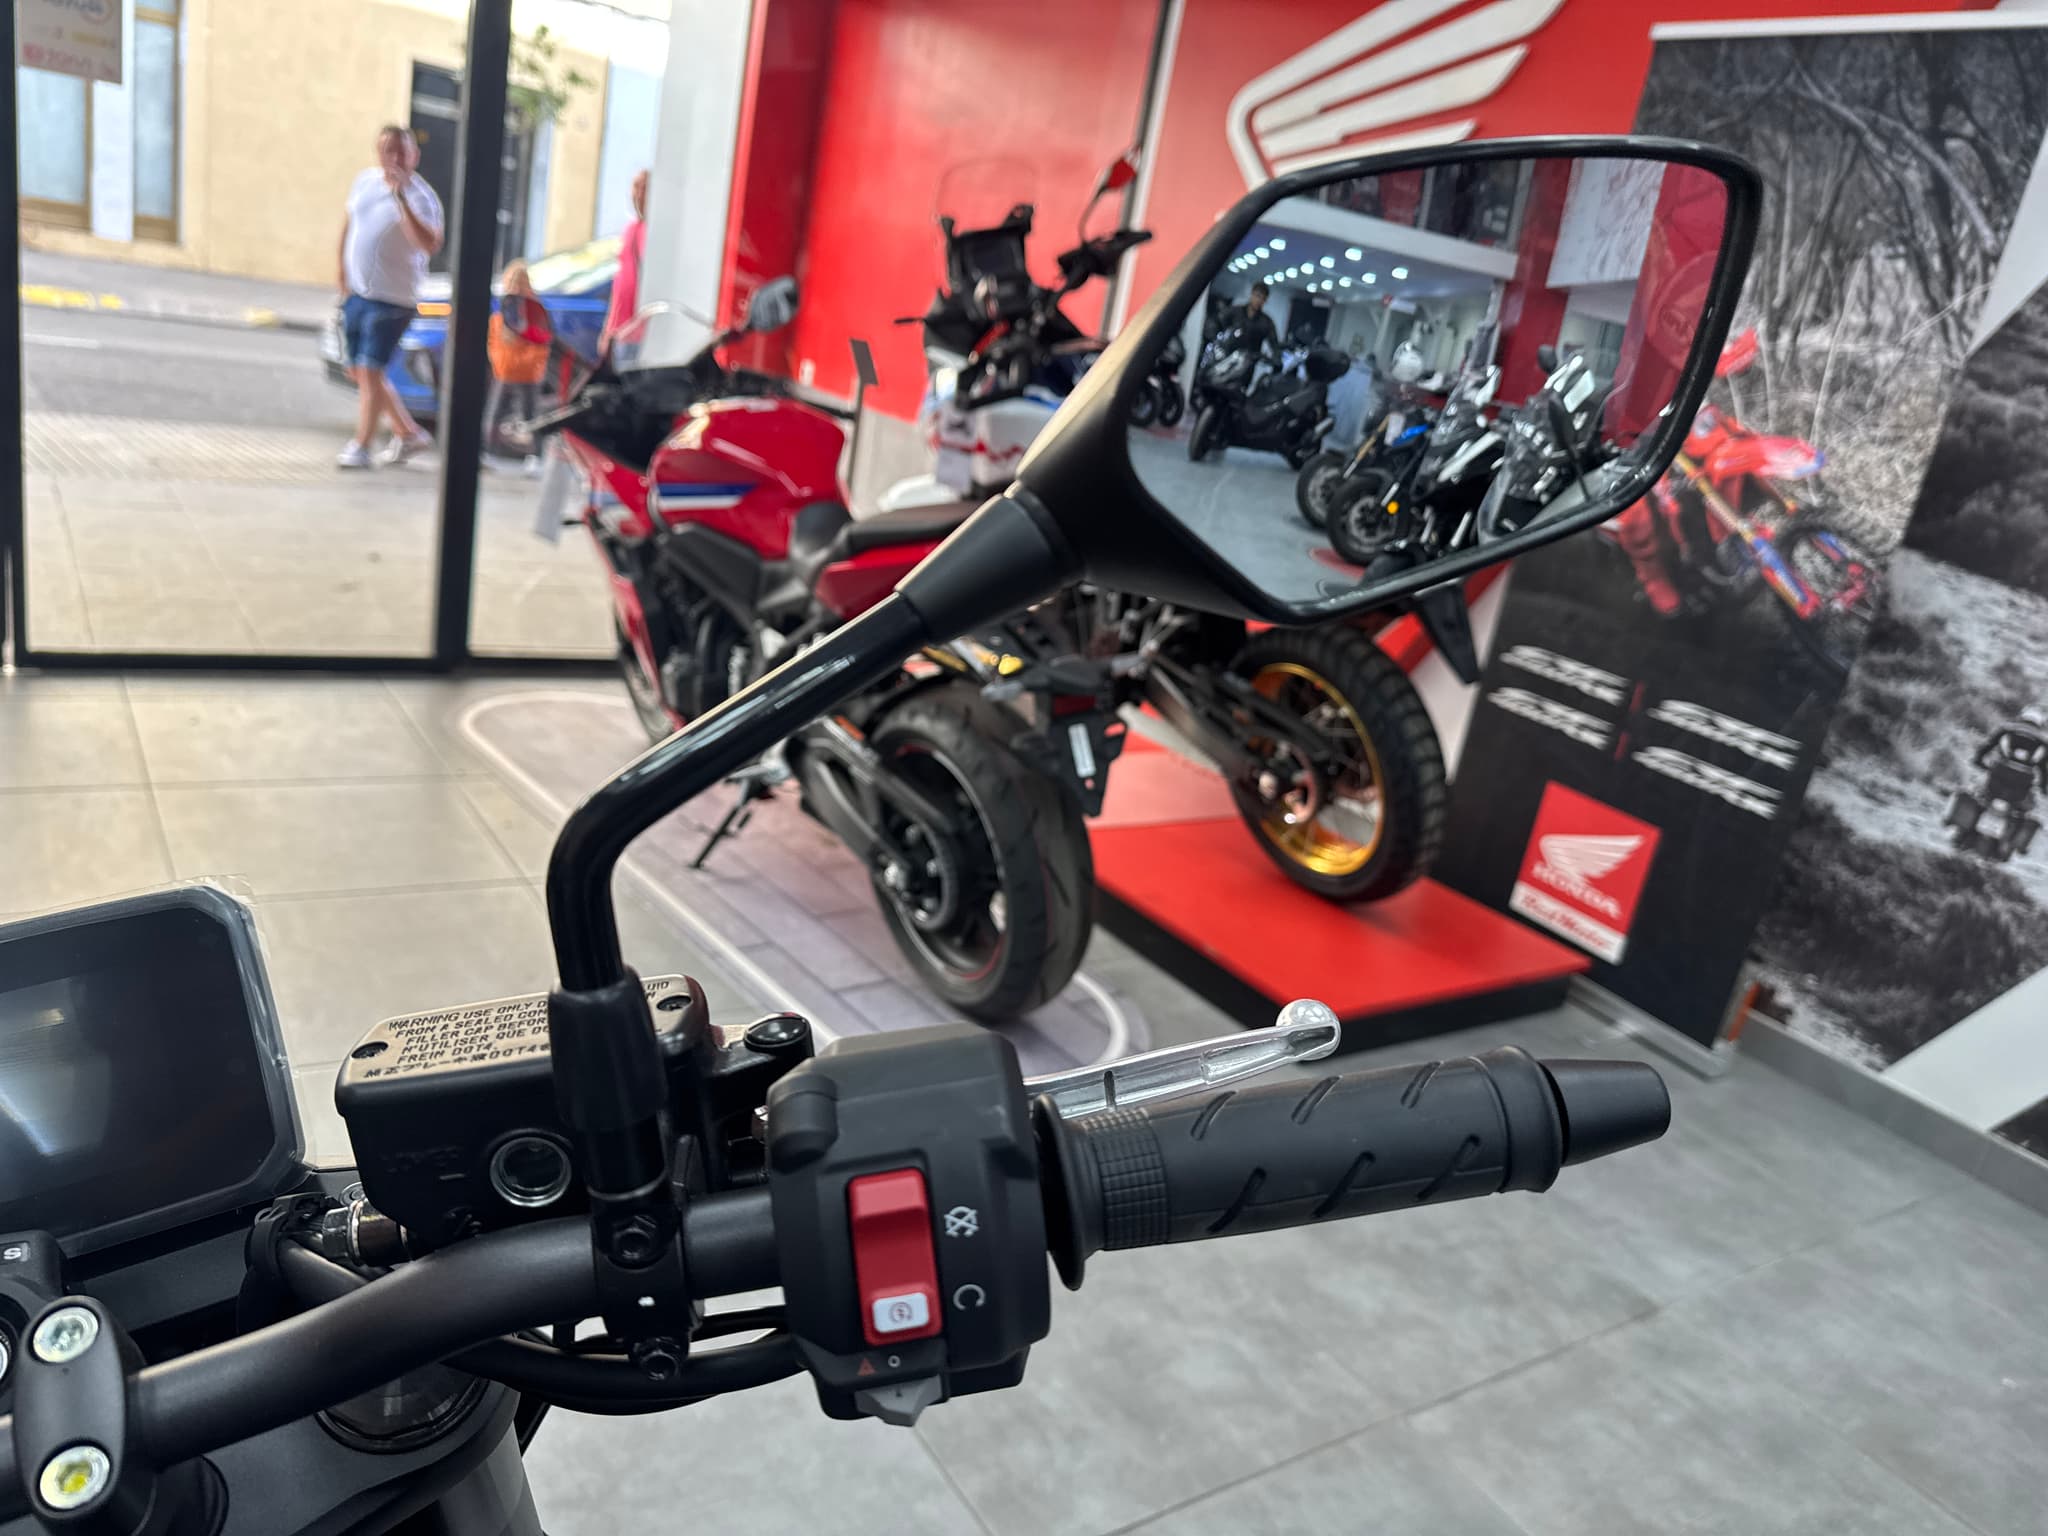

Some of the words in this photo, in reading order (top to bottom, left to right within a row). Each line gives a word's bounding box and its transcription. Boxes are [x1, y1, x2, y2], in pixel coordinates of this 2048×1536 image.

[388, 1012, 460, 1031] WARNING
[463, 1008, 494, 1019] USE
[497, 1002, 533, 1014] ONLY
[395, 1025, 437, 1038] FROM
[440, 1024, 449, 1032] A
[454, 1013, 514, 1029] SEALED
[406, 1030, 460, 1046] FILLER
[464, 1025, 494, 1036] CAP
[497, 1017, 546, 1031] BEFOR
[496, 1028, 527, 1040] QUE
[397, 1049, 445, 1065] FREIN
